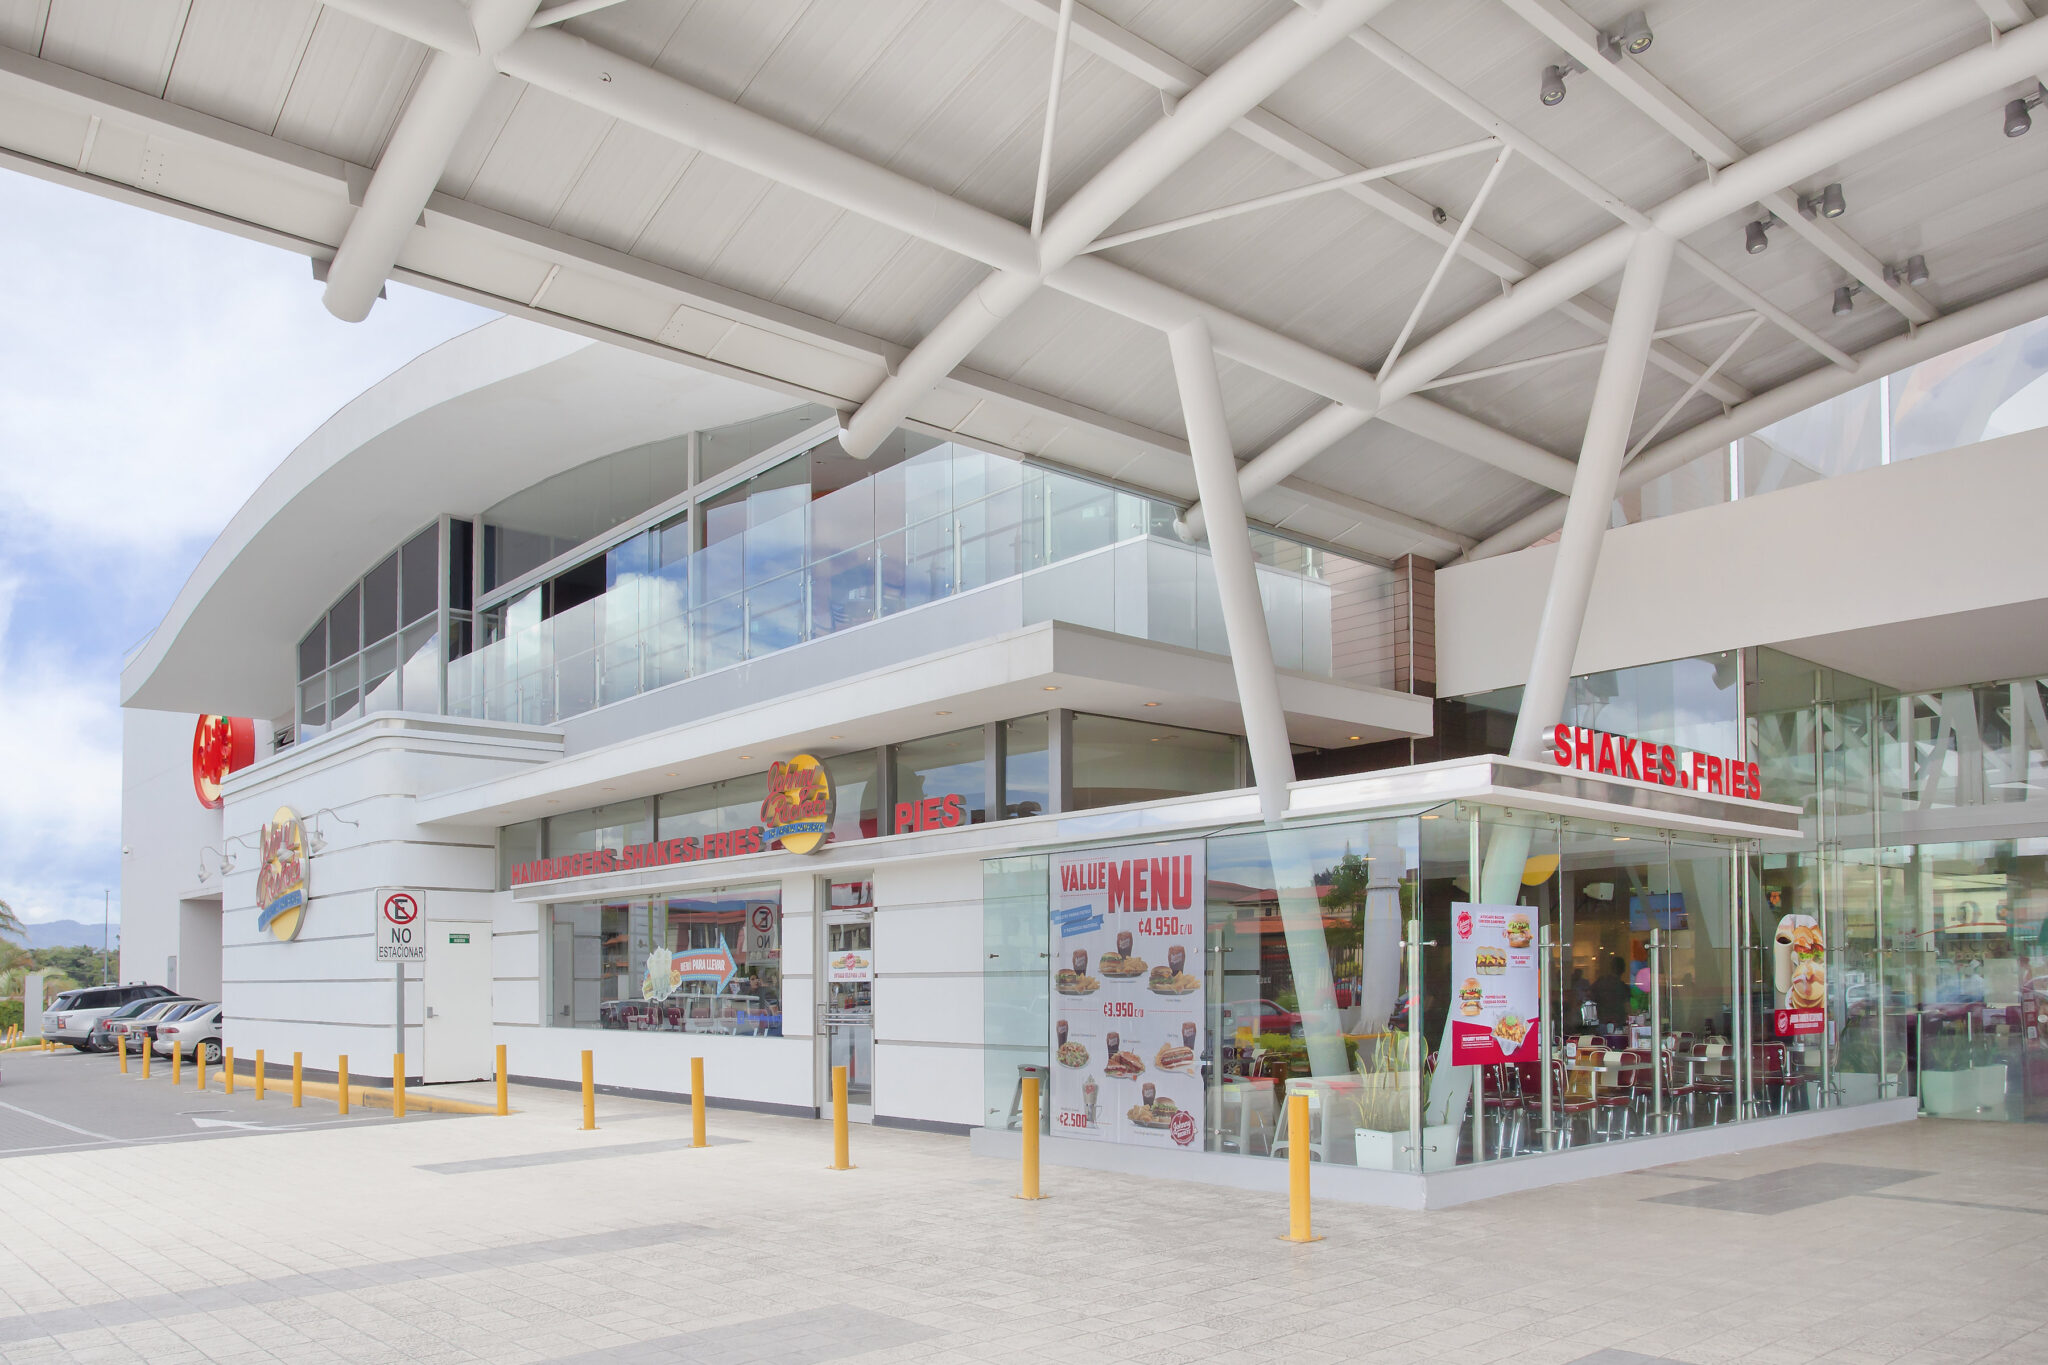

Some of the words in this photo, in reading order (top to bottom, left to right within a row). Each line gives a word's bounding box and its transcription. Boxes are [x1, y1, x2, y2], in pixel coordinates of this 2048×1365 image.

[895, 793, 961, 834] PIES
[1060, 861, 1106, 892] VALUE
[1107, 855, 1192, 913] MENU
[391, 928, 412, 943] NO
[379, 946, 424, 958] ESTACIONAR
[706, 959, 726, 971] LLEVAR
